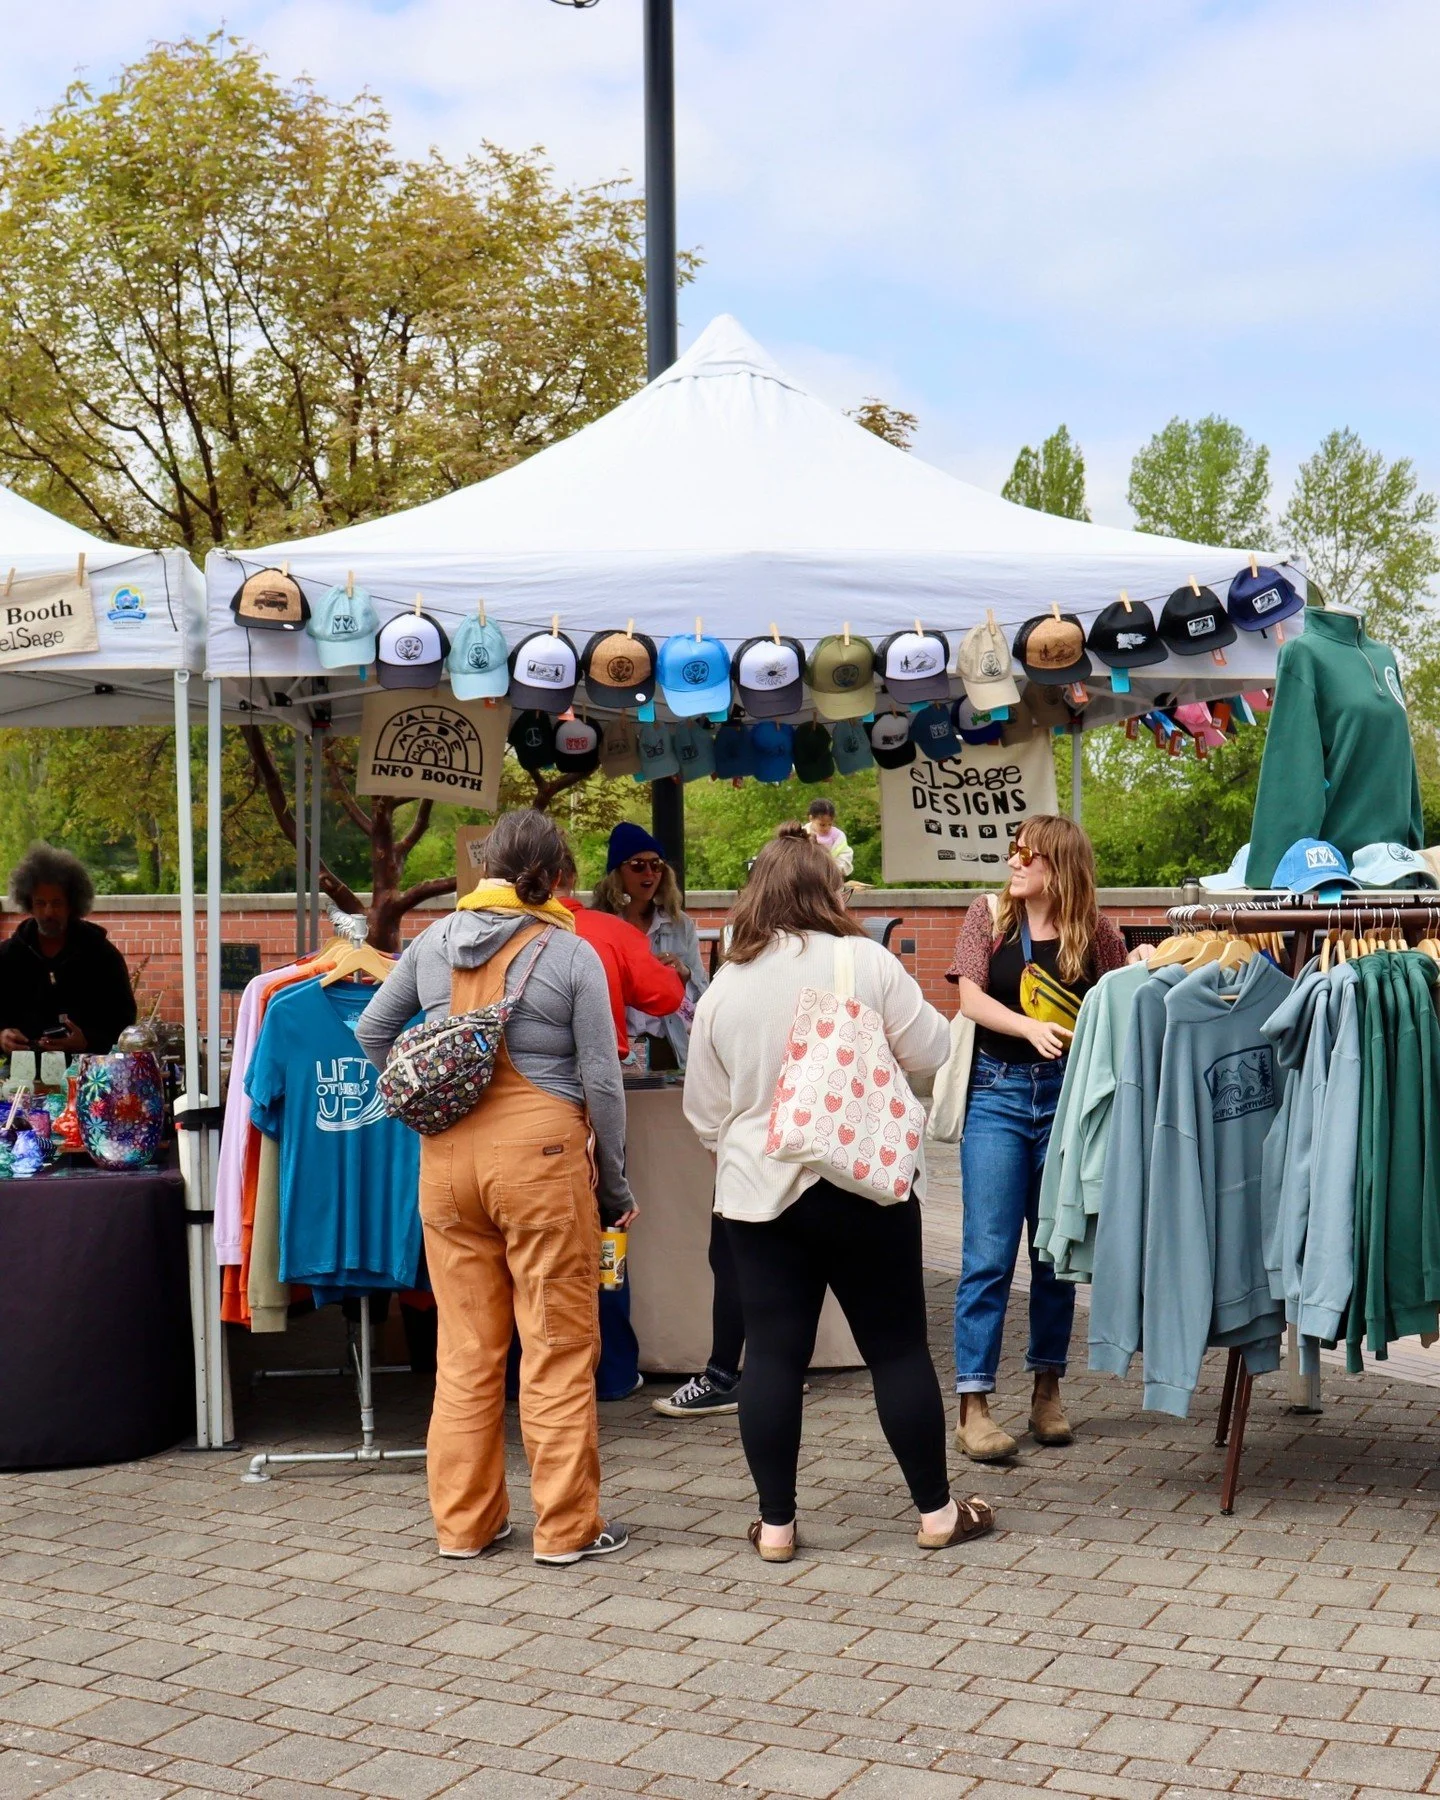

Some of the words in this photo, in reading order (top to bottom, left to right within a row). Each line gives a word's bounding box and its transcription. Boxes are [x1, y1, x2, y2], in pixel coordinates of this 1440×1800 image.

[6, 599, 73, 625] Booth
[0, 627, 65, 651] elSage
[392, 709, 477, 743] VALLEY
[398, 725, 462, 754] MADE
[410, 739, 449, 765] MARKET
[371, 764, 414, 778] INFO
[421, 768, 483, 792] BOOTH
[912, 786, 1027, 816] DESIGNS
[316, 1056, 372, 1082] LIFT
[316, 1080, 370, 1097] OTHERS
[319, 1096, 364, 1121] UP
[1213, 1107, 1234, 1119] CIFIC
